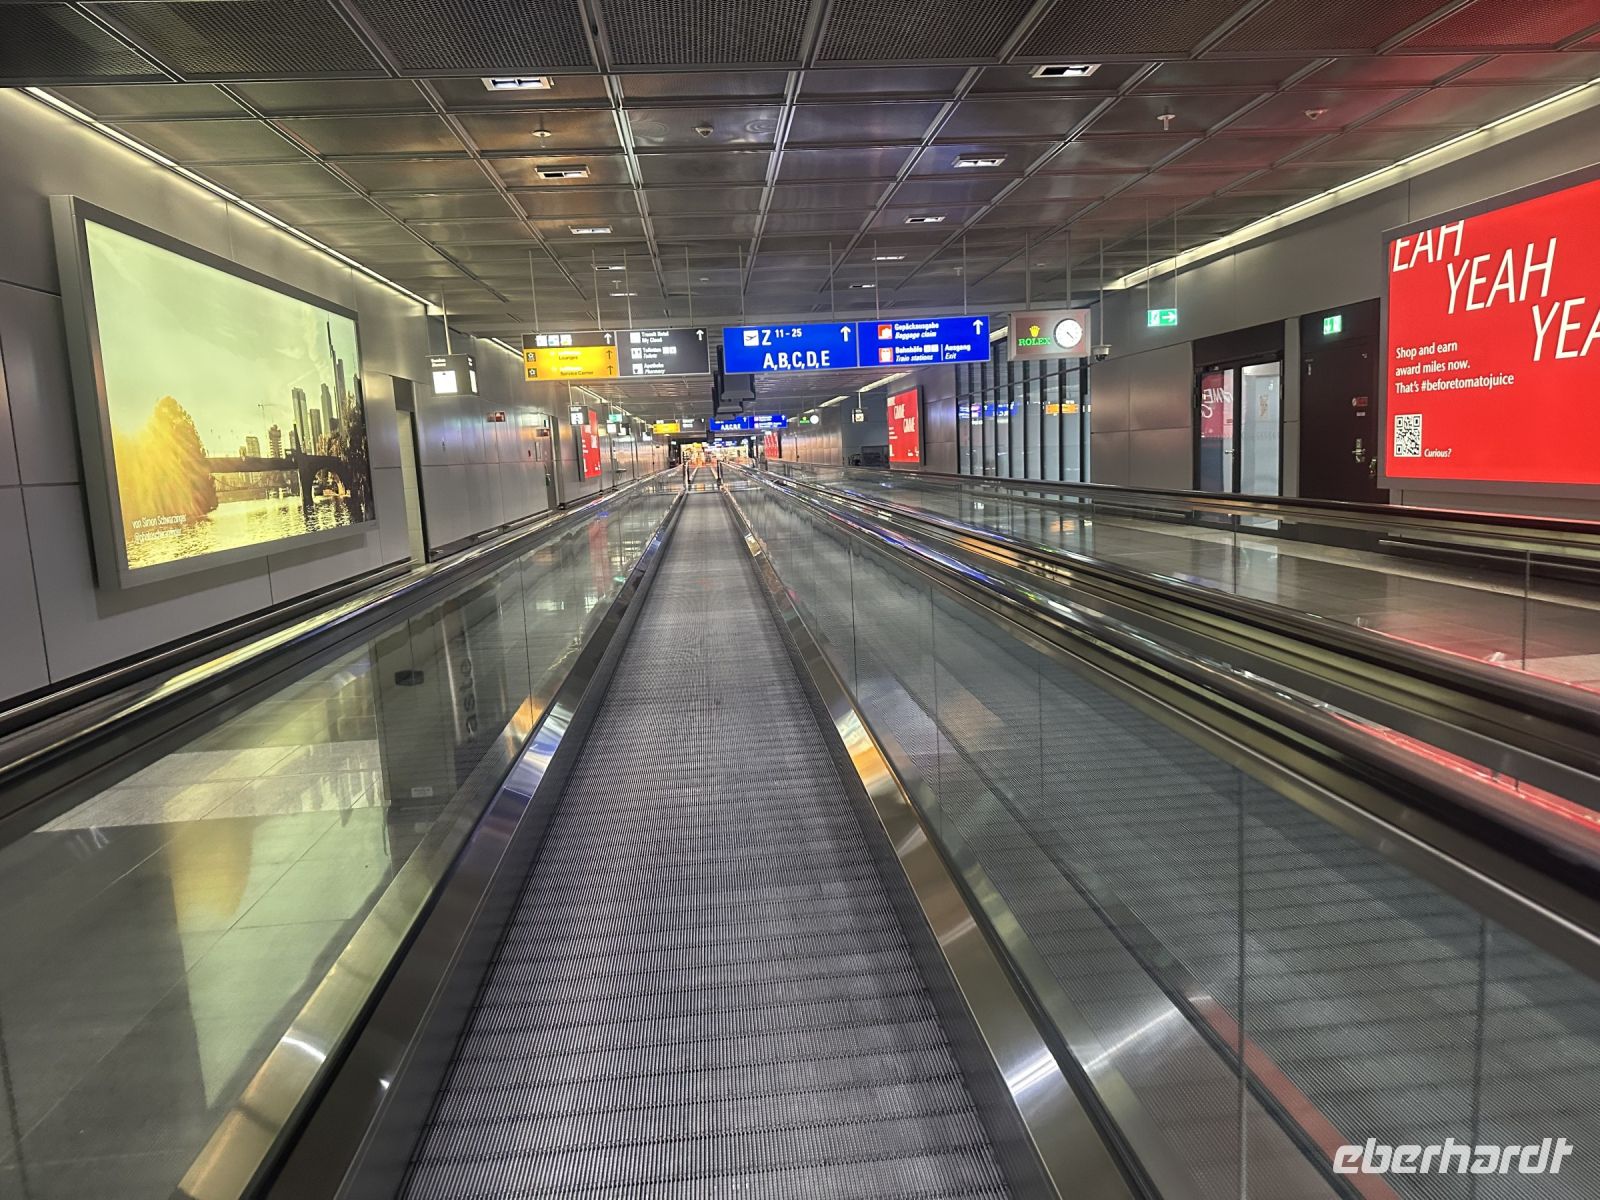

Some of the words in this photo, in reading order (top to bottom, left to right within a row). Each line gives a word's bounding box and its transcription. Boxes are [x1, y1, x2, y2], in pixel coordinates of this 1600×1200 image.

[1447, 237, 1557, 315] YEAH
[894, 322, 939, 332] Gepäckausgabe
[762, 329, 771, 346] Z
[775, 329, 784, 338] 11
[791, 328, 802, 338] 25
[895, 332, 920, 341] Baggage
[1018, 338, 1051, 346] ROLEX
[763, 350, 830, 370] A,B,C,D,E
[896, 354, 910, 362] Train
[910, 354, 933, 362] stations
[1396, 347, 1417, 360] Shop
[1418, 342, 1435, 356] and
[1437, 342, 1458, 353] earn
[1395, 363, 1420, 377] award
[1422, 361, 1446, 373] miles
[1447, 359, 1470, 370] now.
[1395, 380, 1419, 394] That's
[1421, 373, 1514, 392] #beforetomatojuice
[1424, 448, 1452, 459] Curious?
